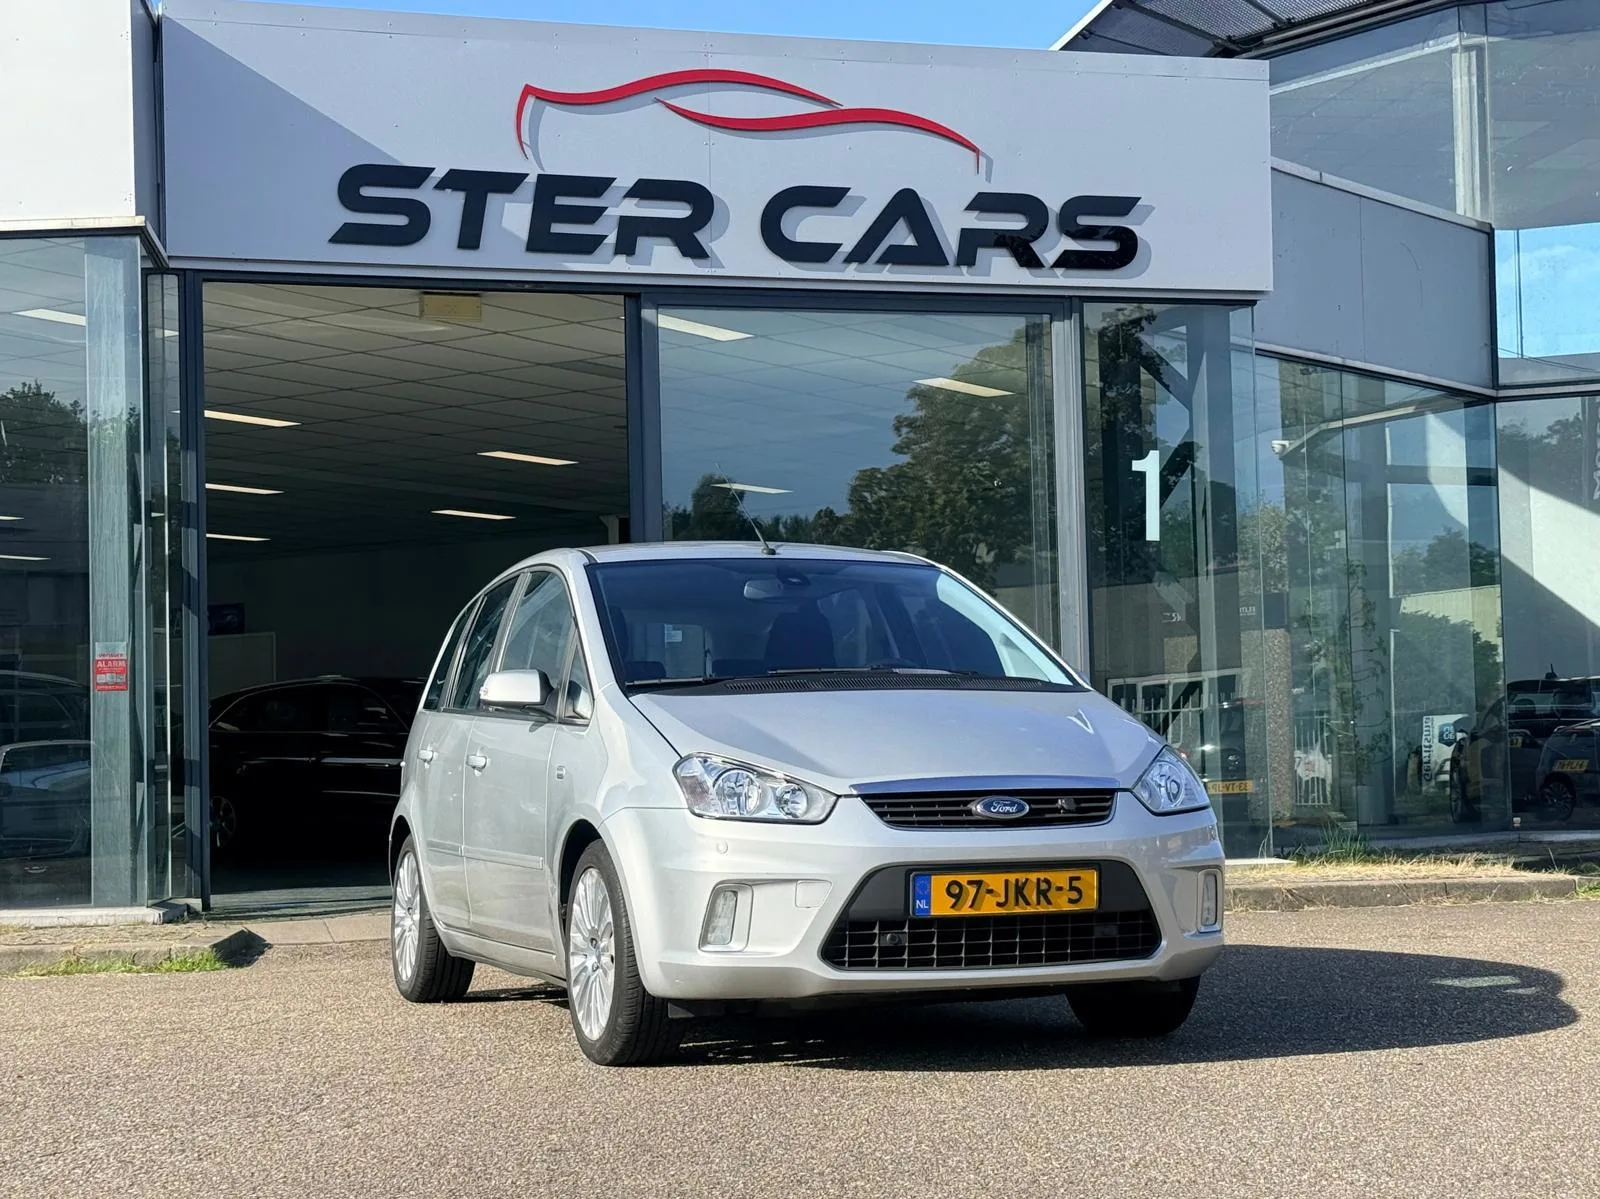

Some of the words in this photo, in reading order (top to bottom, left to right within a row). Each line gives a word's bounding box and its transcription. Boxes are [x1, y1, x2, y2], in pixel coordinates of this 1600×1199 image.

[328, 163, 714, 259] STER
[760, 184, 1142, 270] CARS
[1131, 449, 1160, 541] 1
[97, 660, 126, 668] ALARM
[990, 801, 1018, 814] Ford
[916, 900, 929, 909] NL
[945, 875, 1083, 910] 97-JKR-5
